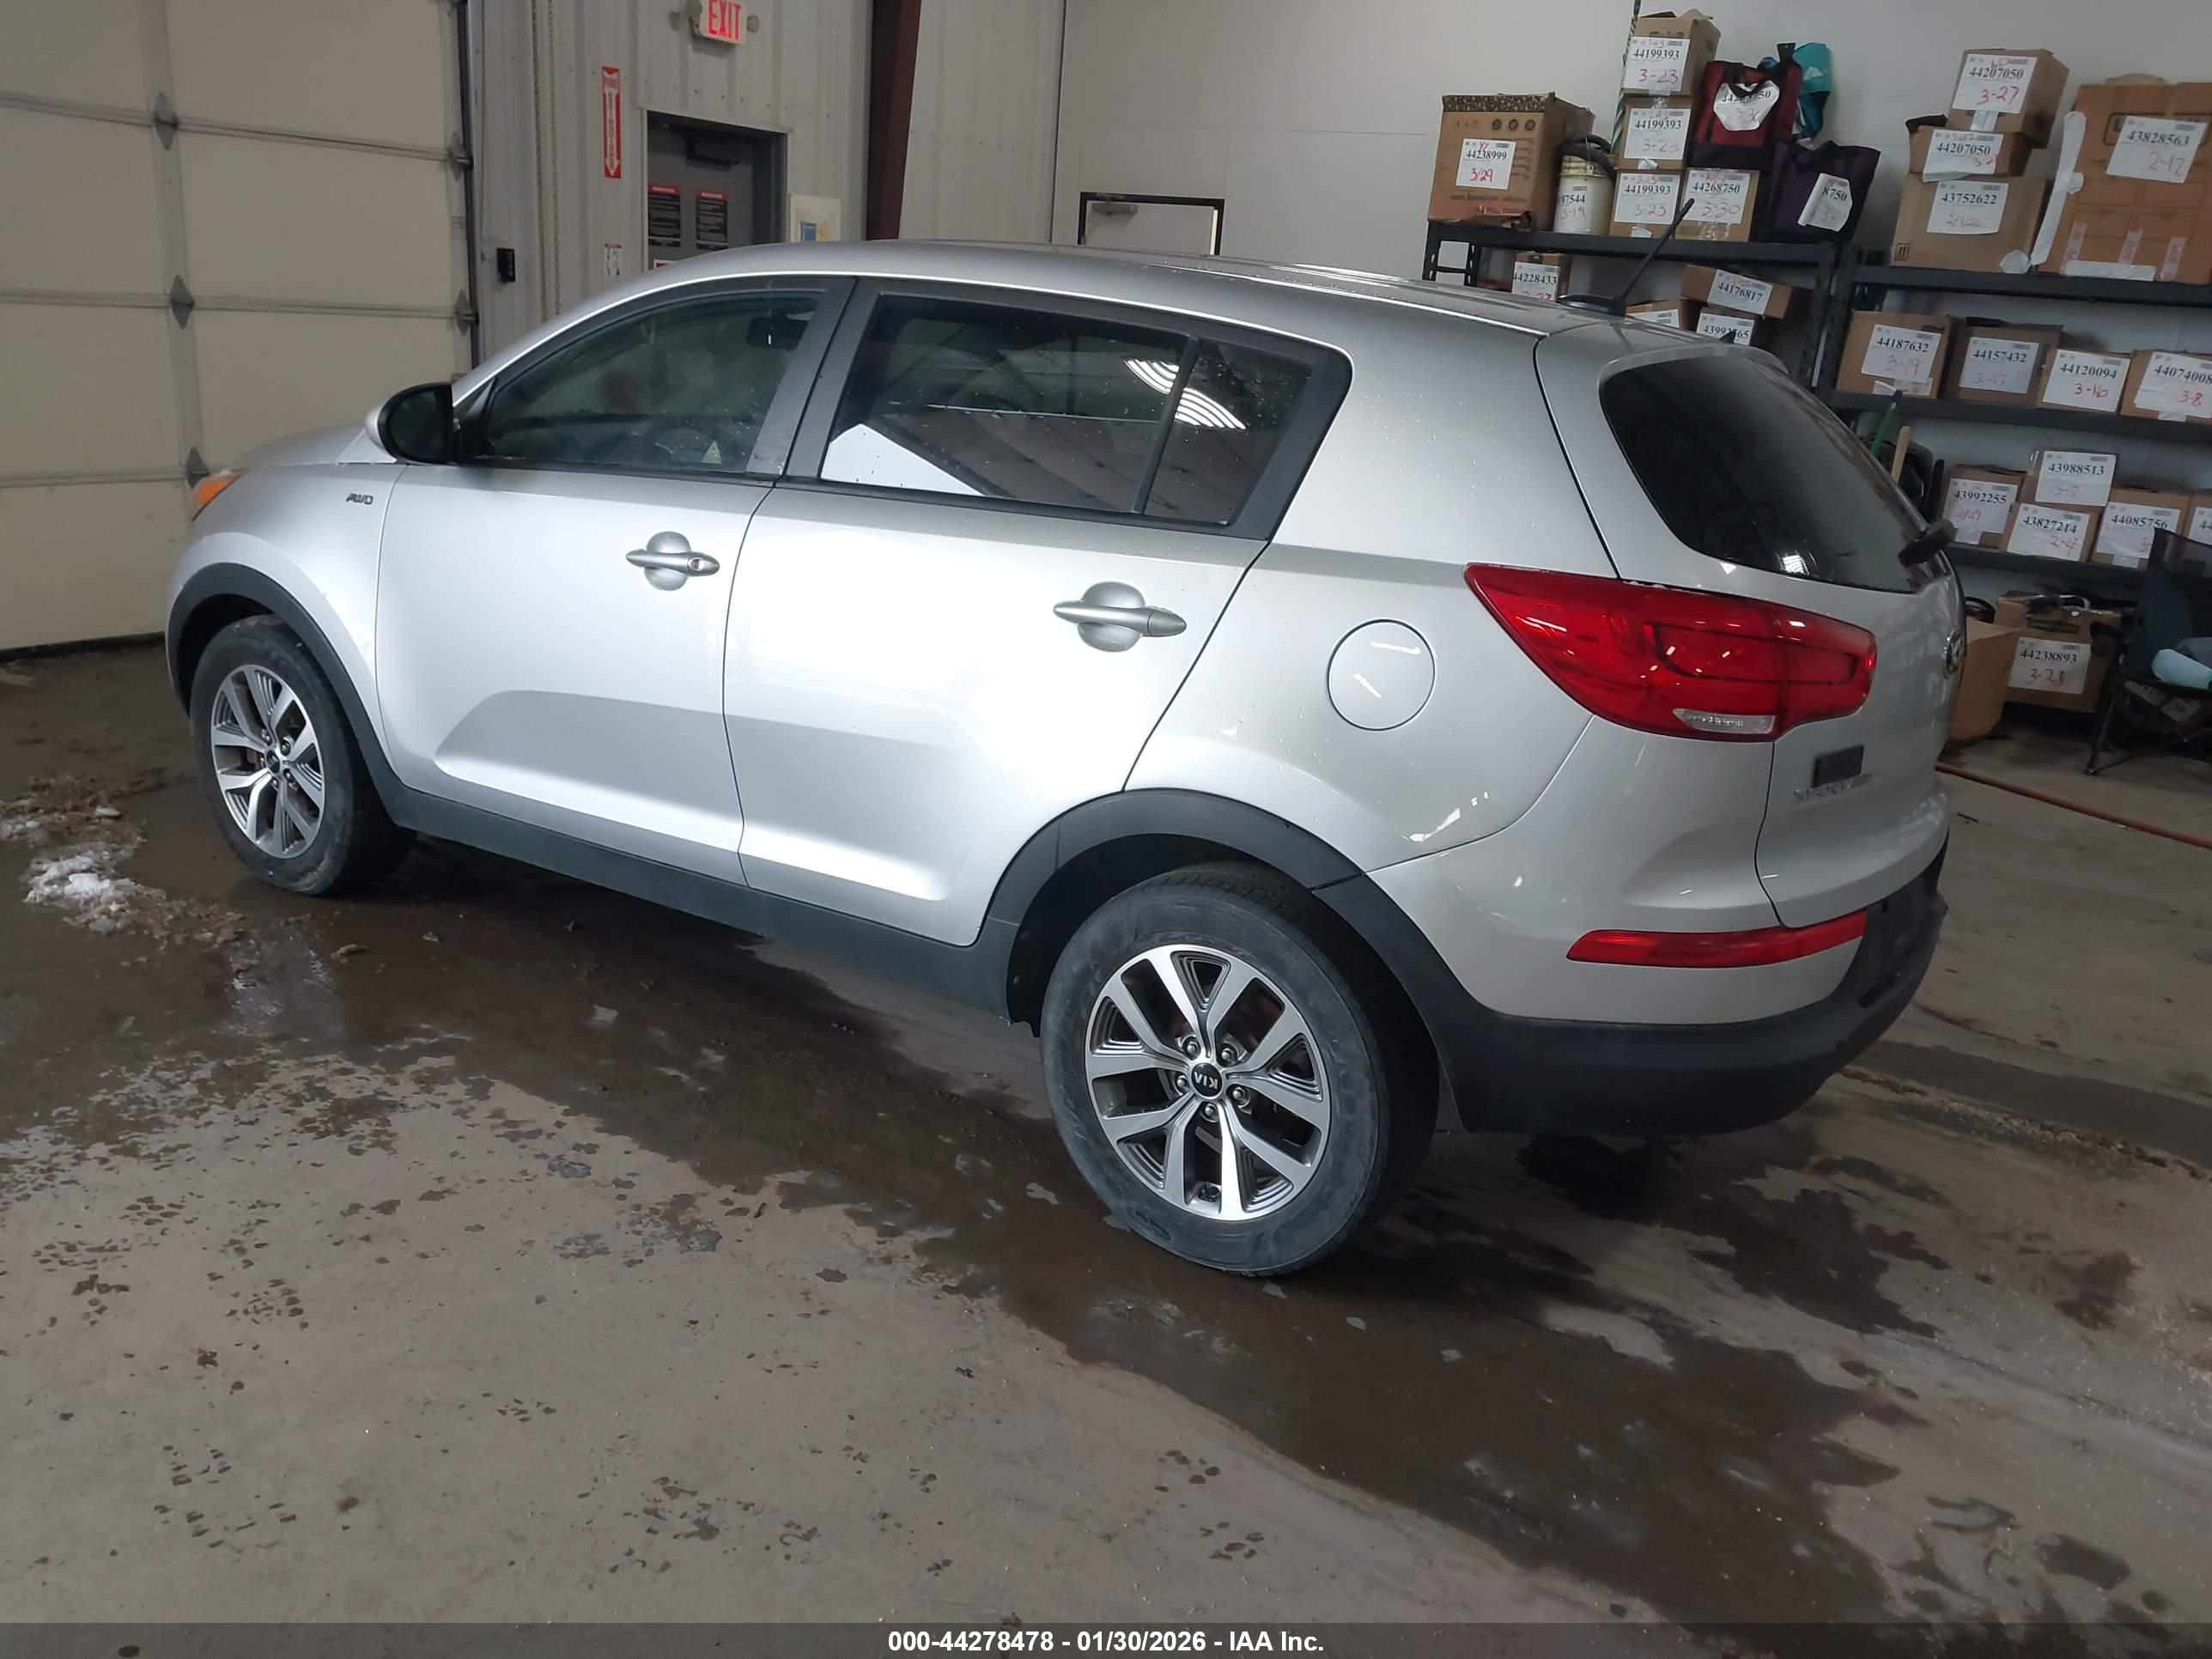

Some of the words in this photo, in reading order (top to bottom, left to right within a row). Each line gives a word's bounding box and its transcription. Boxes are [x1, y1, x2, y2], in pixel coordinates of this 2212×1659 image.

[708, 0, 741, 40] EXIT
[1633, 49, 1680, 60] 44199393
[1639, 69, 1679, 85] 3-23
[1969, 67, 2024, 80] 44207050
[1977, 86, 2021, 105] 3-27
[1634, 119, 1681, 131] 44199393
[1642, 138, 1680, 153] 3-23
[2126, 130, 2190, 147] 43828563
[1466, 149, 1507, 161] 44238999
[1936, 143, 1991, 155] 44207050
[1470, 167, 1493, 183] 3/29
[1624, 184, 1671, 196] 44199393
[1692, 181, 1741, 194] 44268750
[1821, 187, 1848, 202] 8750
[1941, 192, 1997, 205] 43752622
[1635, 204, 1667, 216] 3-23
[1512, 272, 1558, 285] 44228433
[1717, 282, 1763, 302] 44176817
[1876, 337, 1929, 353] 44187632
[1972, 349, 2027, 363] 44157432
[2060, 363, 2118, 380] 44120094
[2048, 463, 2105, 476] 43988513
[346, 493, 374, 505] AWD
[1954, 490, 2008, 505] 43992255
[2022, 515, 2078, 534] 43827214
[2111, 514, 2168, 530] 44085756
[2020, 649, 2077, 664] 44238893
